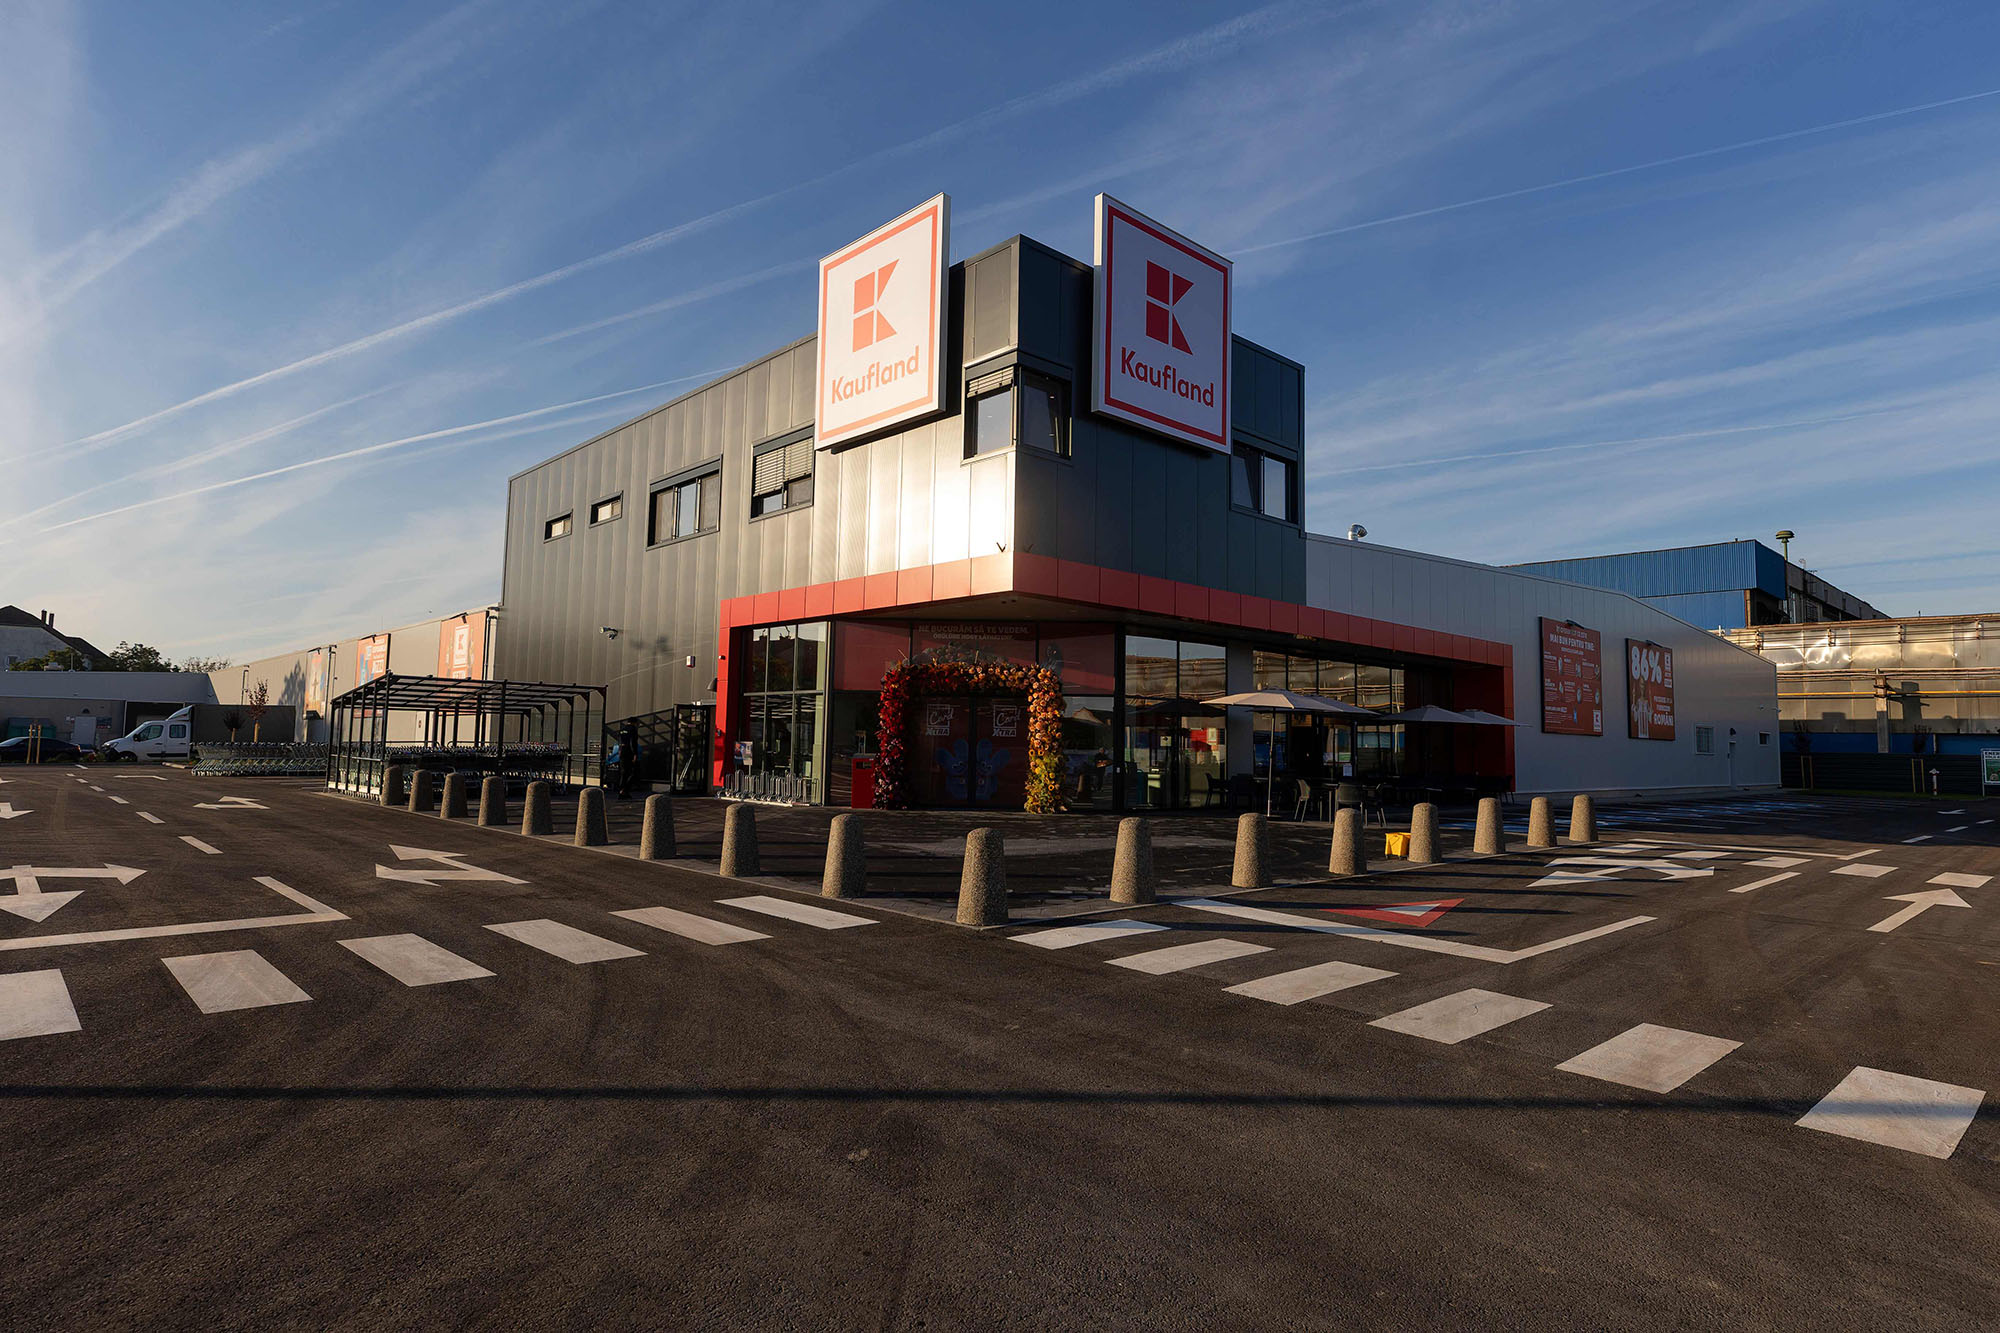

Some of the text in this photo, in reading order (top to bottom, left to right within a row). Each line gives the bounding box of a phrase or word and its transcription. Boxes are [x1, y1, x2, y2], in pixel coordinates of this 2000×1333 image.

[831, 346, 920, 404] Kaufland
[1121, 346, 1214, 408] Kaufland
[1632, 646, 1662, 684] 86%
[930, 707, 954, 725] Card
[996, 708, 1021, 726] Card
